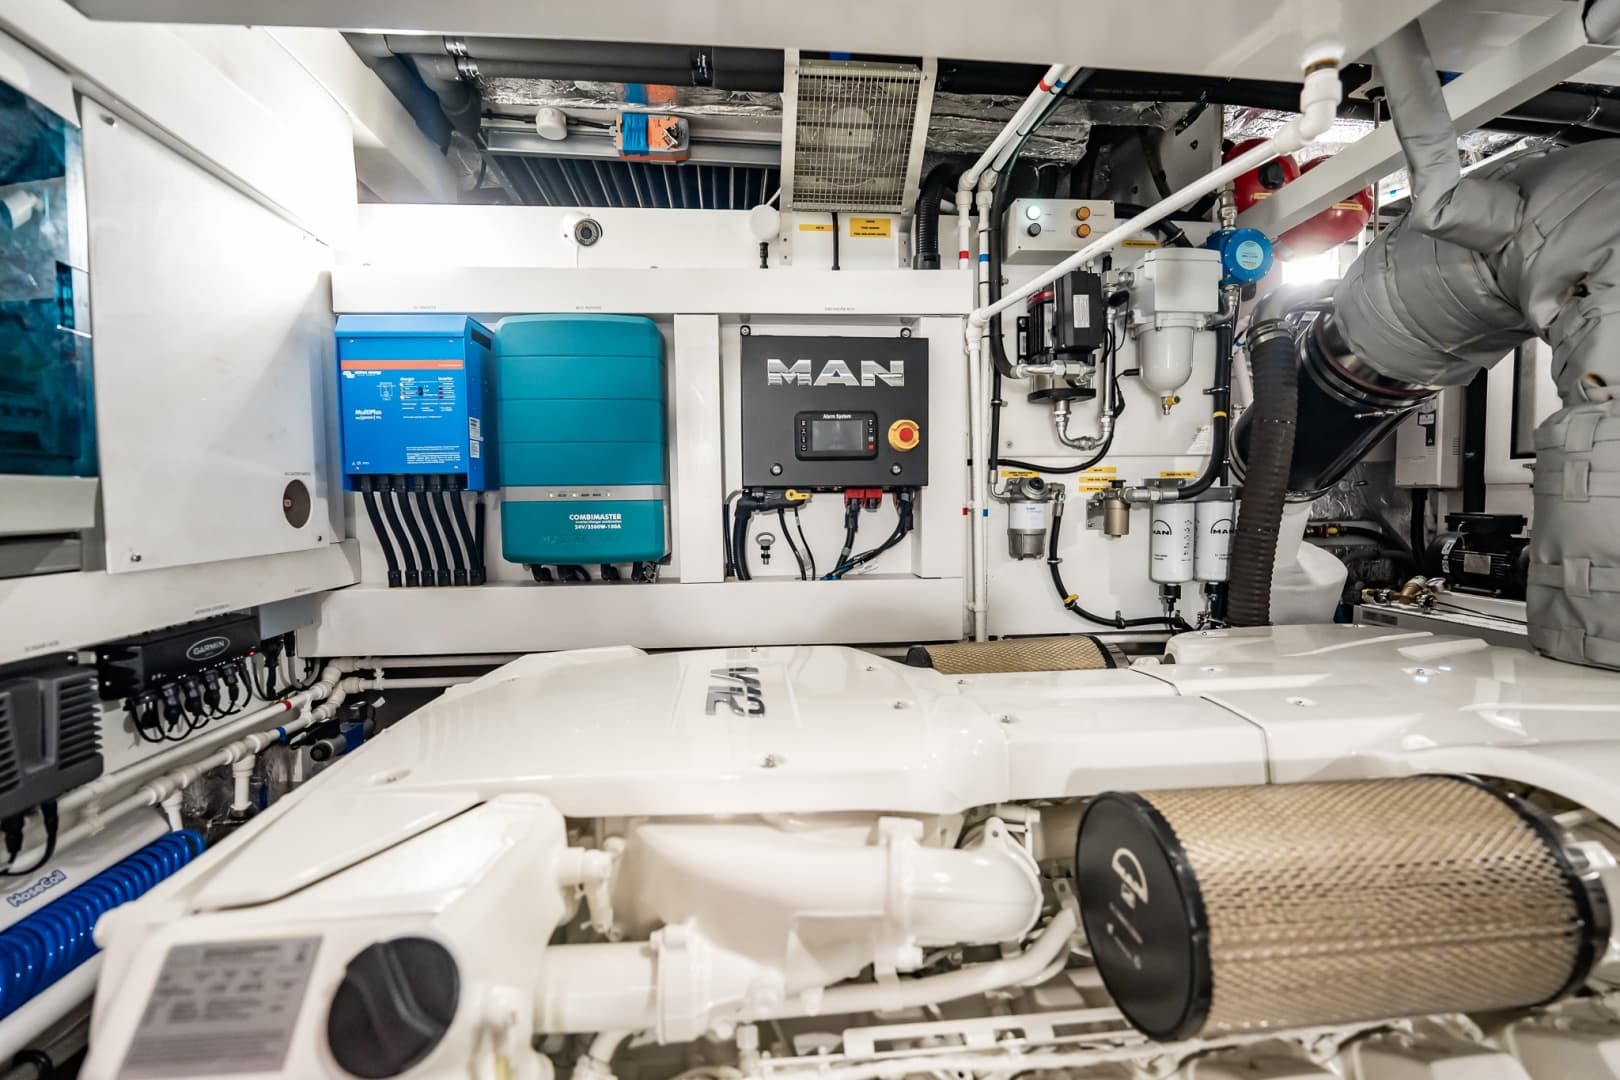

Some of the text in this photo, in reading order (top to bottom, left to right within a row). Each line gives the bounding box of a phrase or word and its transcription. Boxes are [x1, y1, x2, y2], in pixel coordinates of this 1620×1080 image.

[767, 359, 905, 387] MAN
[569, 513, 622, 521] COMBIMASTER
[192, 640, 225, 655] GARMIN
[7, 870, 66, 907] HoseCoil
